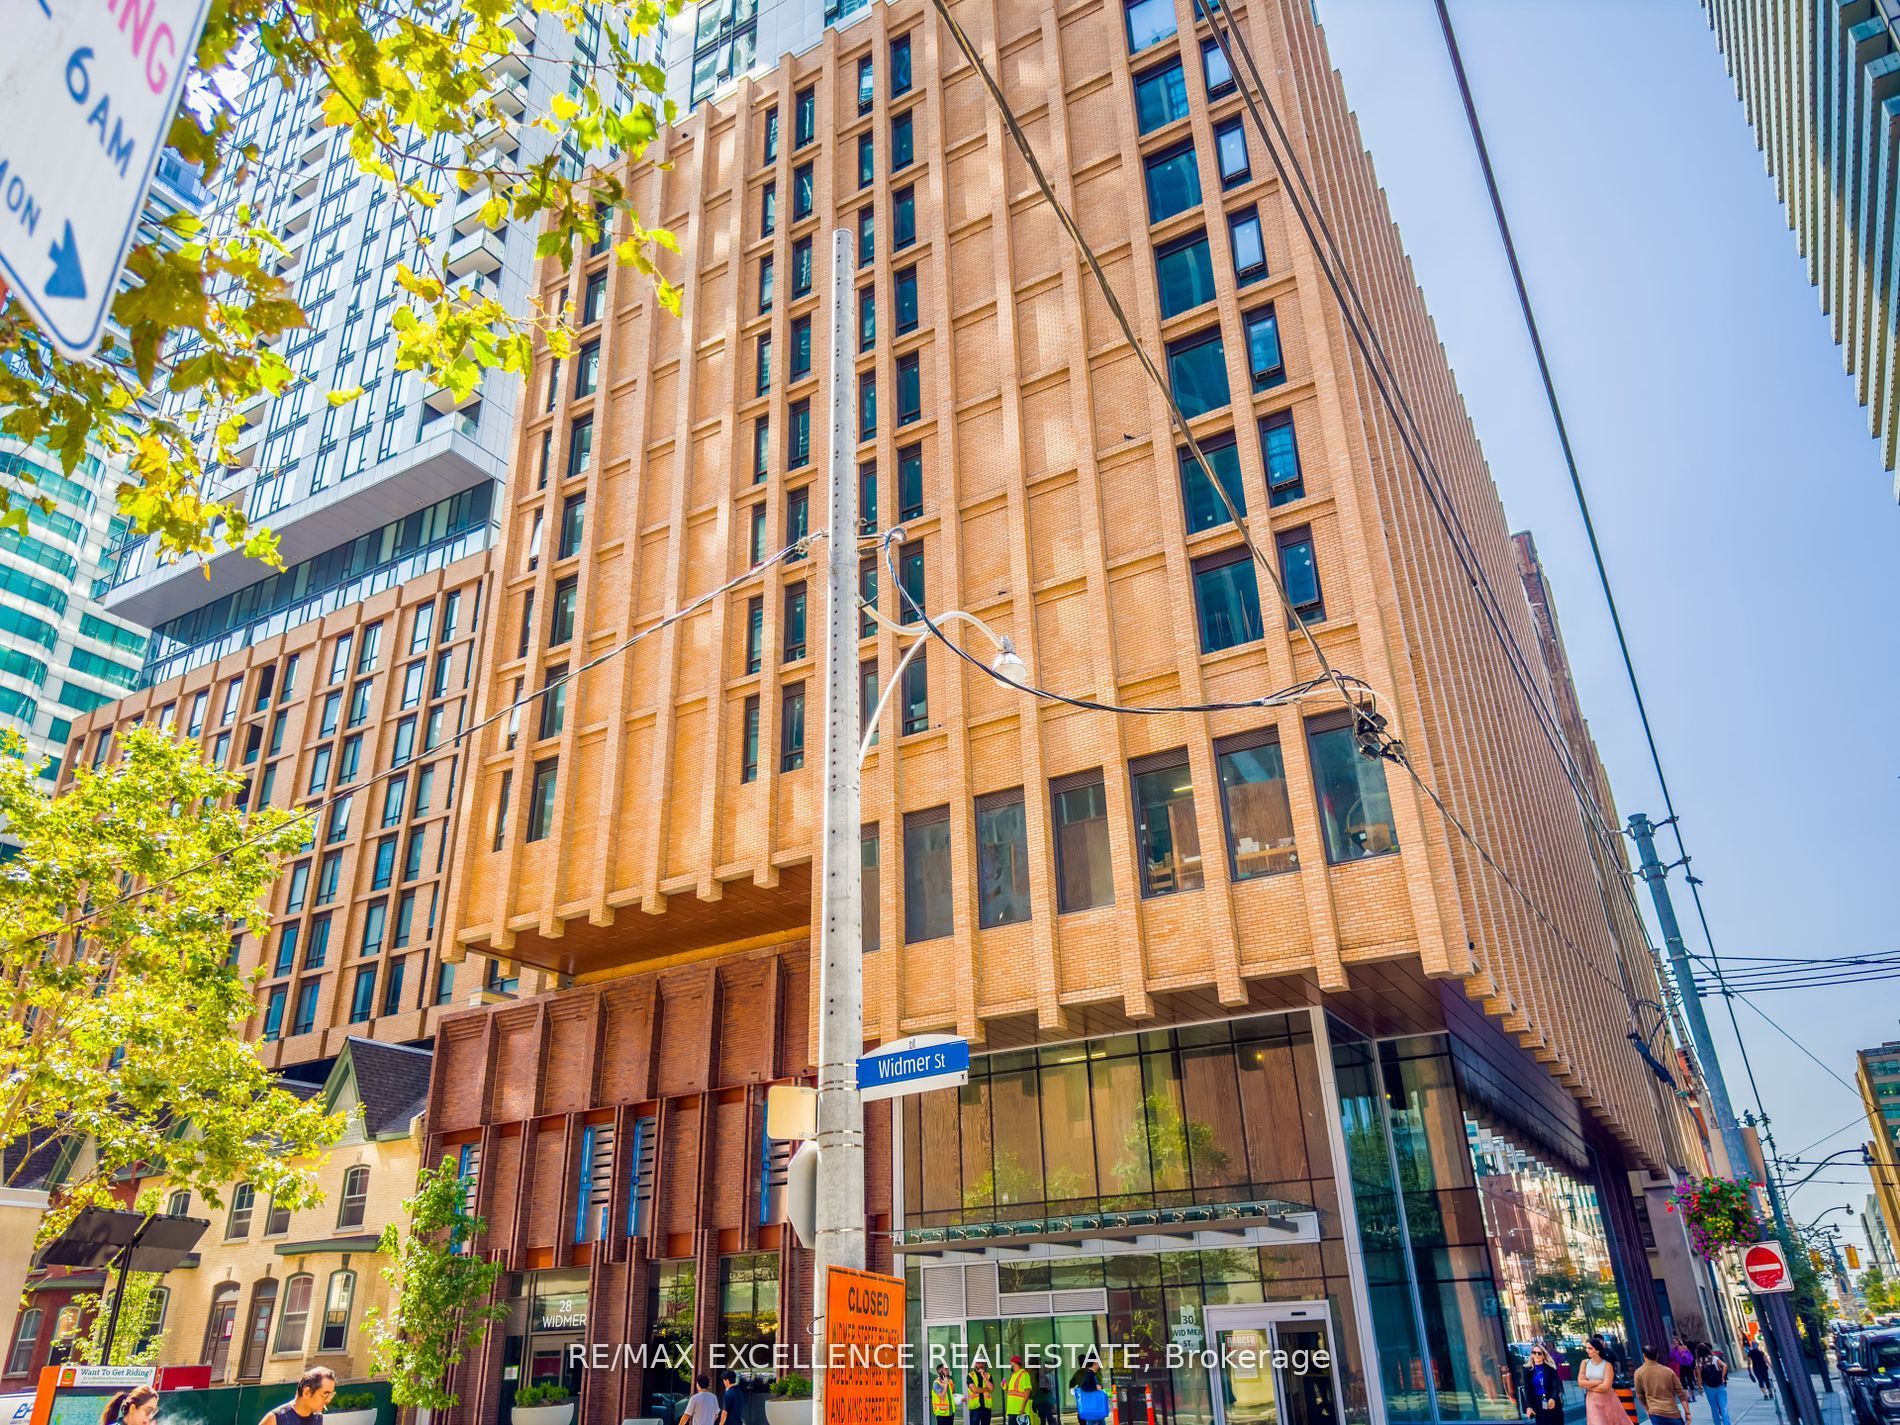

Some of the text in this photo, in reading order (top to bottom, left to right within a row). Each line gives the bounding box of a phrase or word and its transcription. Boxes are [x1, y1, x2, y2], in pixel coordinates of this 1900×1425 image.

[107, 0, 175, 95] NG
[878, 1053, 946, 1079] Widmer St
[559, 1299, 573, 1312] 28
[848, 1286, 889, 1317] CLOSED
[542, 1314, 587, 1328] WIDMER
[1182, 1315, 1194, 1325] 30
[126, 1369, 153, 1378] Riding?
[831, 1396, 845, 1424] AND
[847, 1397, 863, 1424] KING
[865, 1397, 885, 1424] STREET
